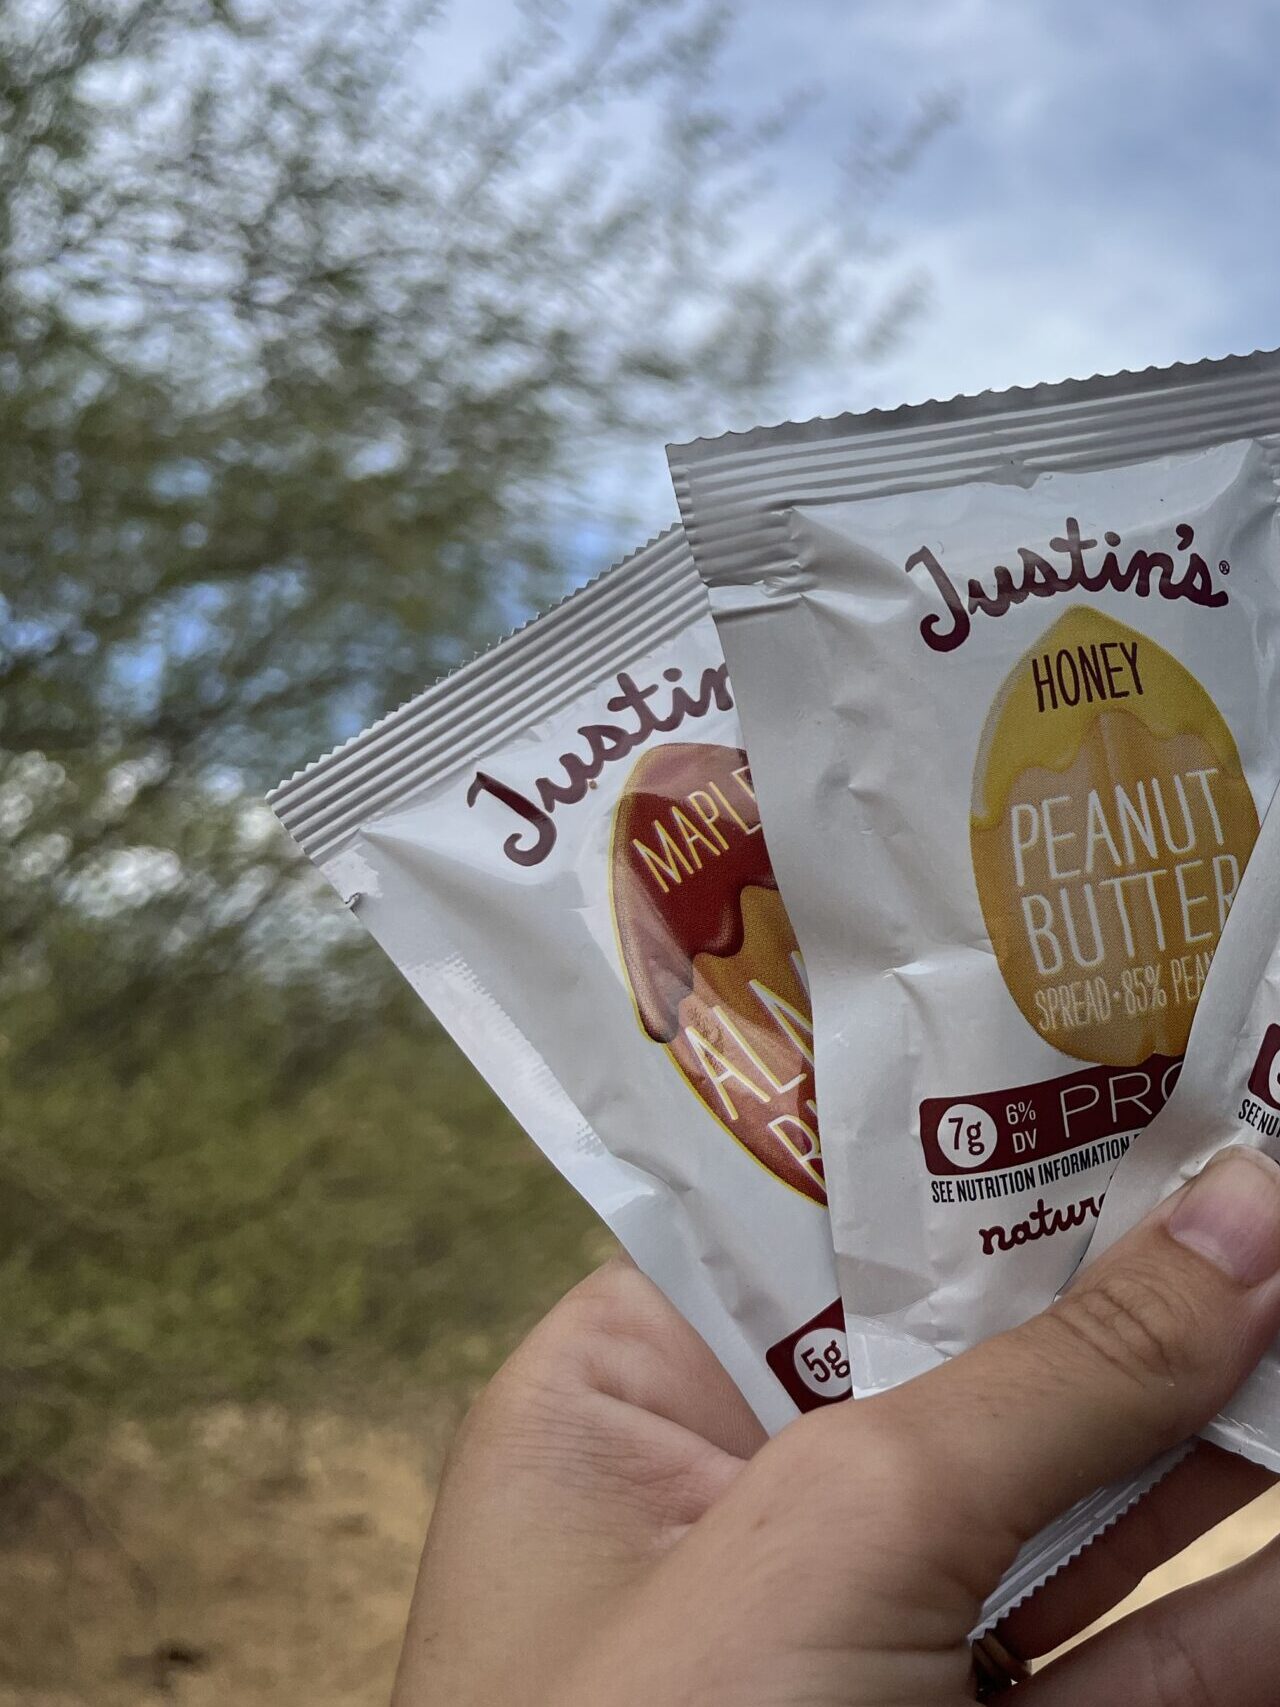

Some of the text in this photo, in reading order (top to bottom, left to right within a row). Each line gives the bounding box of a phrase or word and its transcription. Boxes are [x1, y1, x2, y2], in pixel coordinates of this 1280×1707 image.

[1032, 642, 1144, 713] HONEY
[1010, 768, 1225, 888] PEANUT
[1034, 976, 1112, 1031] SPREAD
[1170, 951, 1215, 1005] PEA
[1006, 1100, 1037, 1125] 6%
[1238, 1098, 1262, 1129] SEE
[948, 1116, 985, 1156] 7g
[1012, 1128, 1038, 1154] DV
[930, 1180, 955, 1204] SEE
[956, 1167, 1036, 1202] NUTRITION
[800, 1339, 851, 1383] 5g
